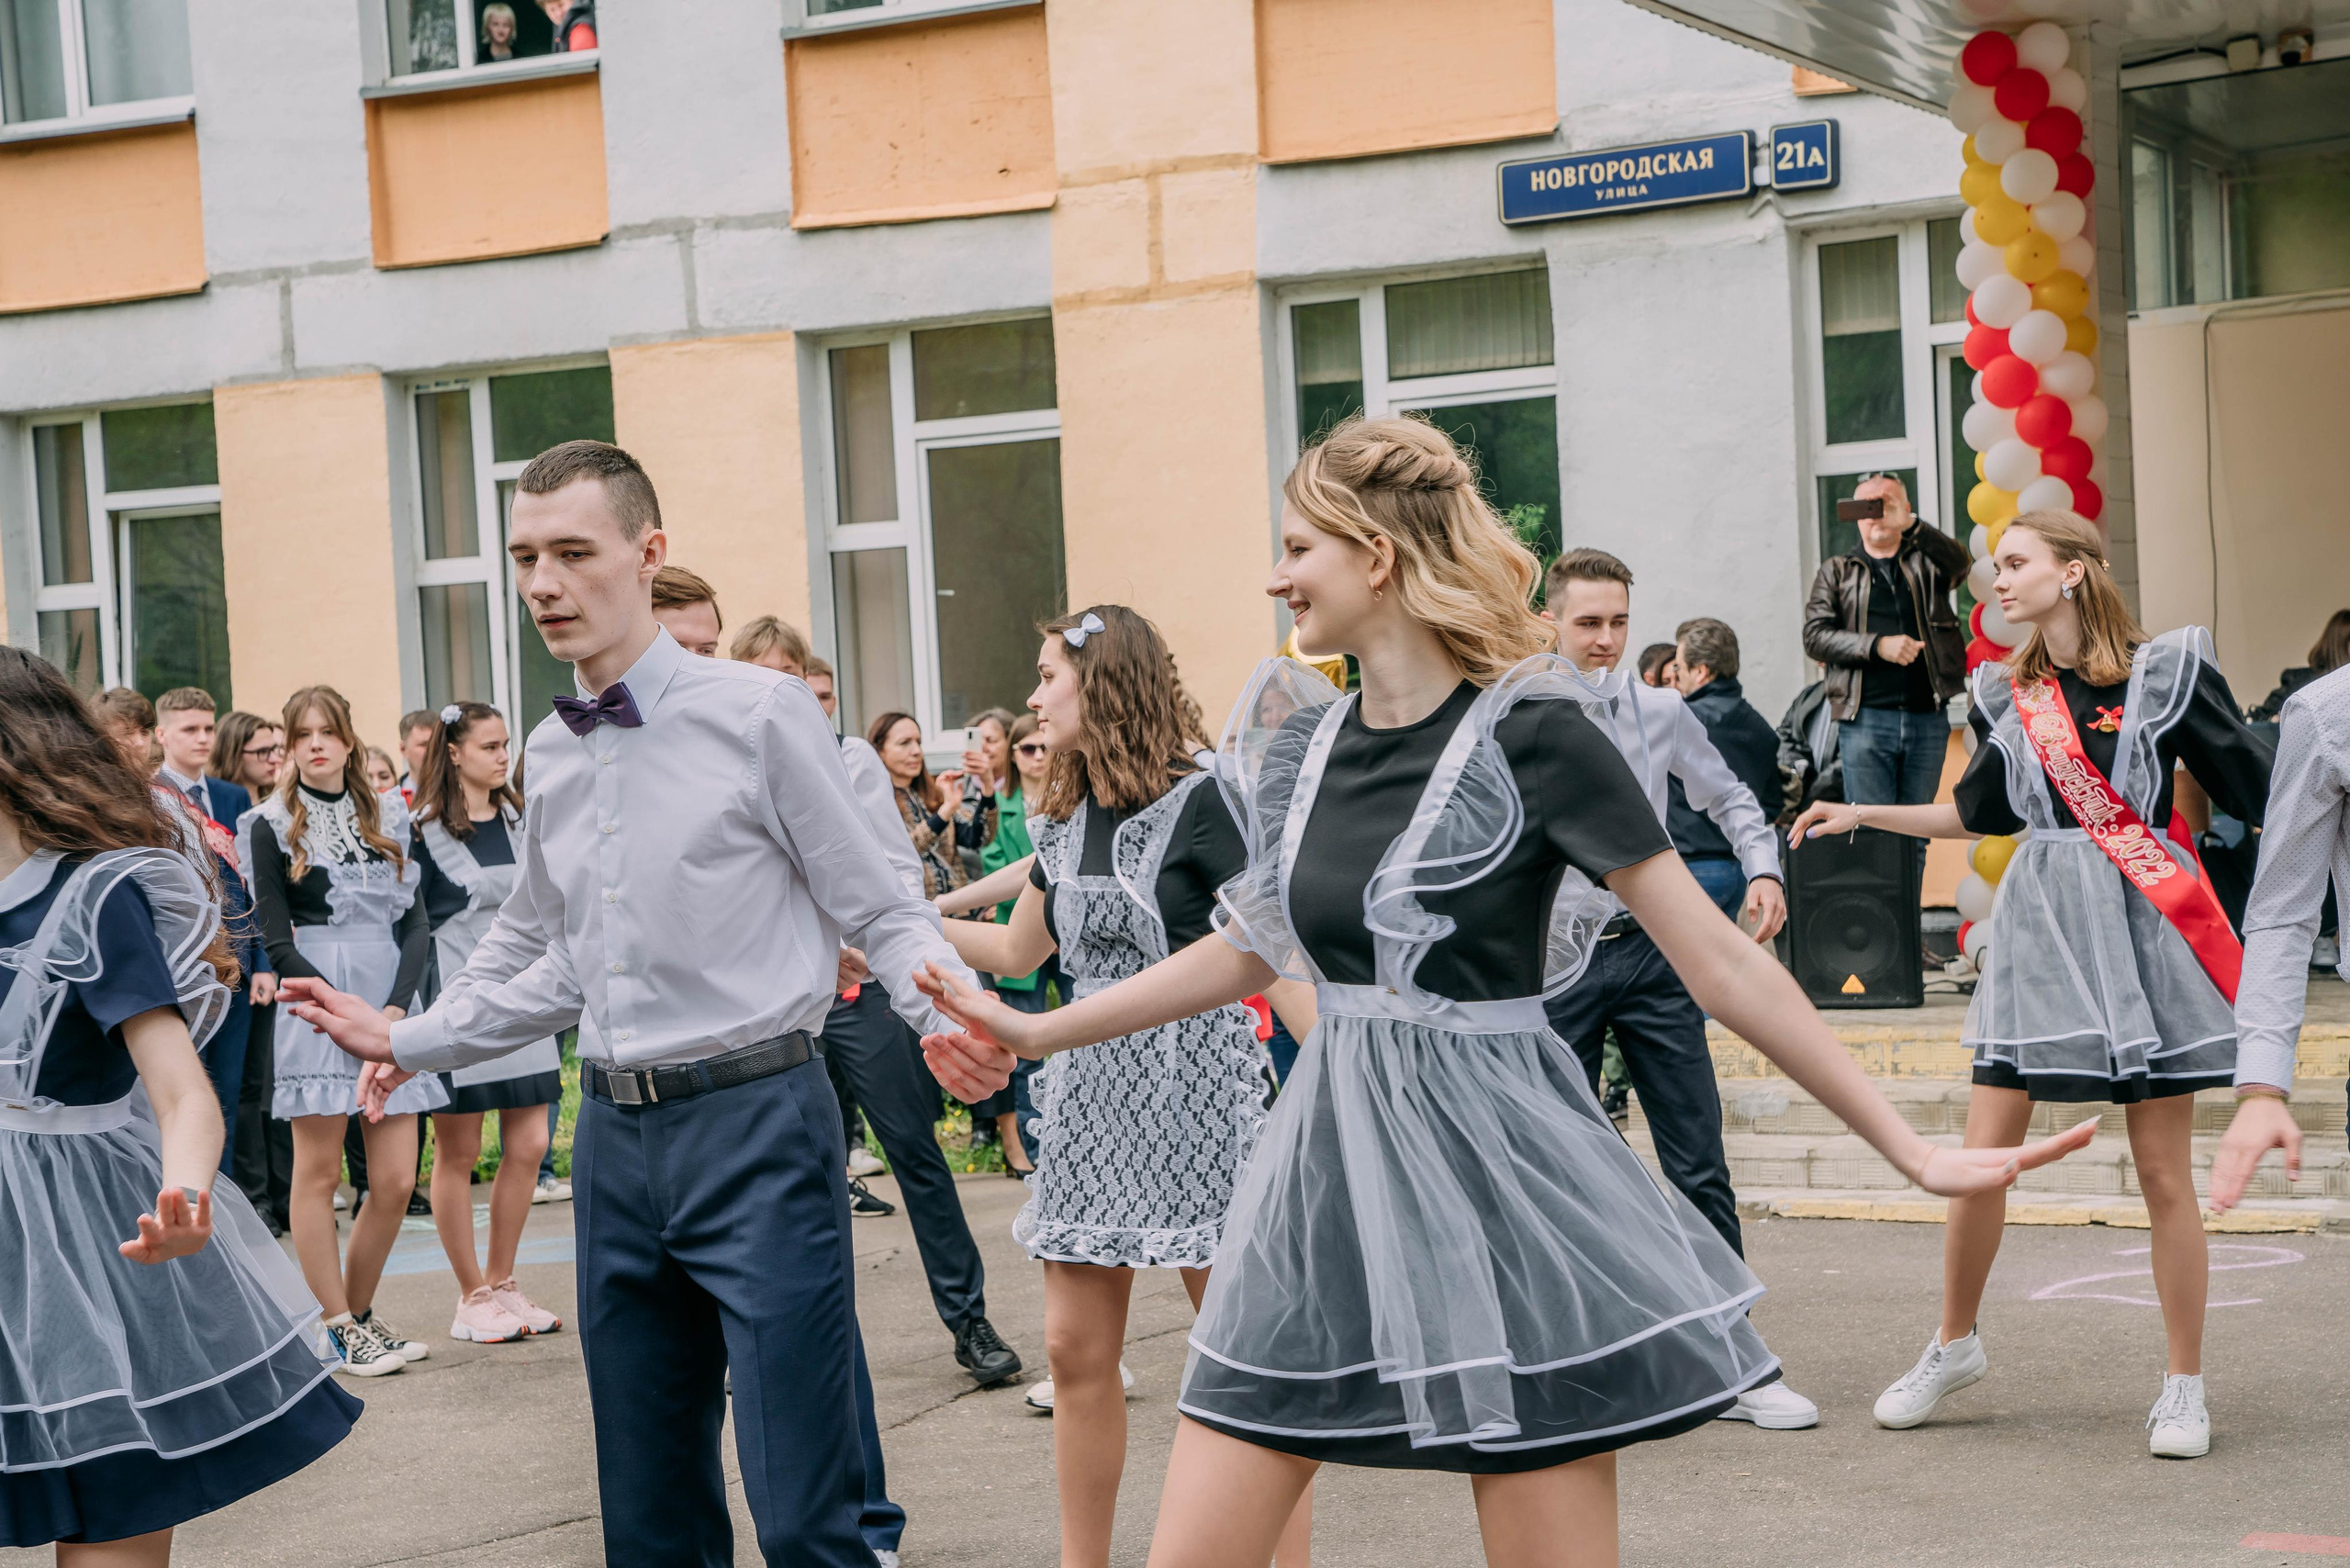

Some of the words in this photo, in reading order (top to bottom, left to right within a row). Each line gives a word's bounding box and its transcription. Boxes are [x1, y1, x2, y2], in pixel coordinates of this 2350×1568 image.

[1530, 147, 1714, 192] НОВГОРОДСКАЯ
[1775, 140, 1826, 171] 21А
[1595, 184, 1649, 201] УЛИЦА
[2106, 823, 2177, 886] 2022
